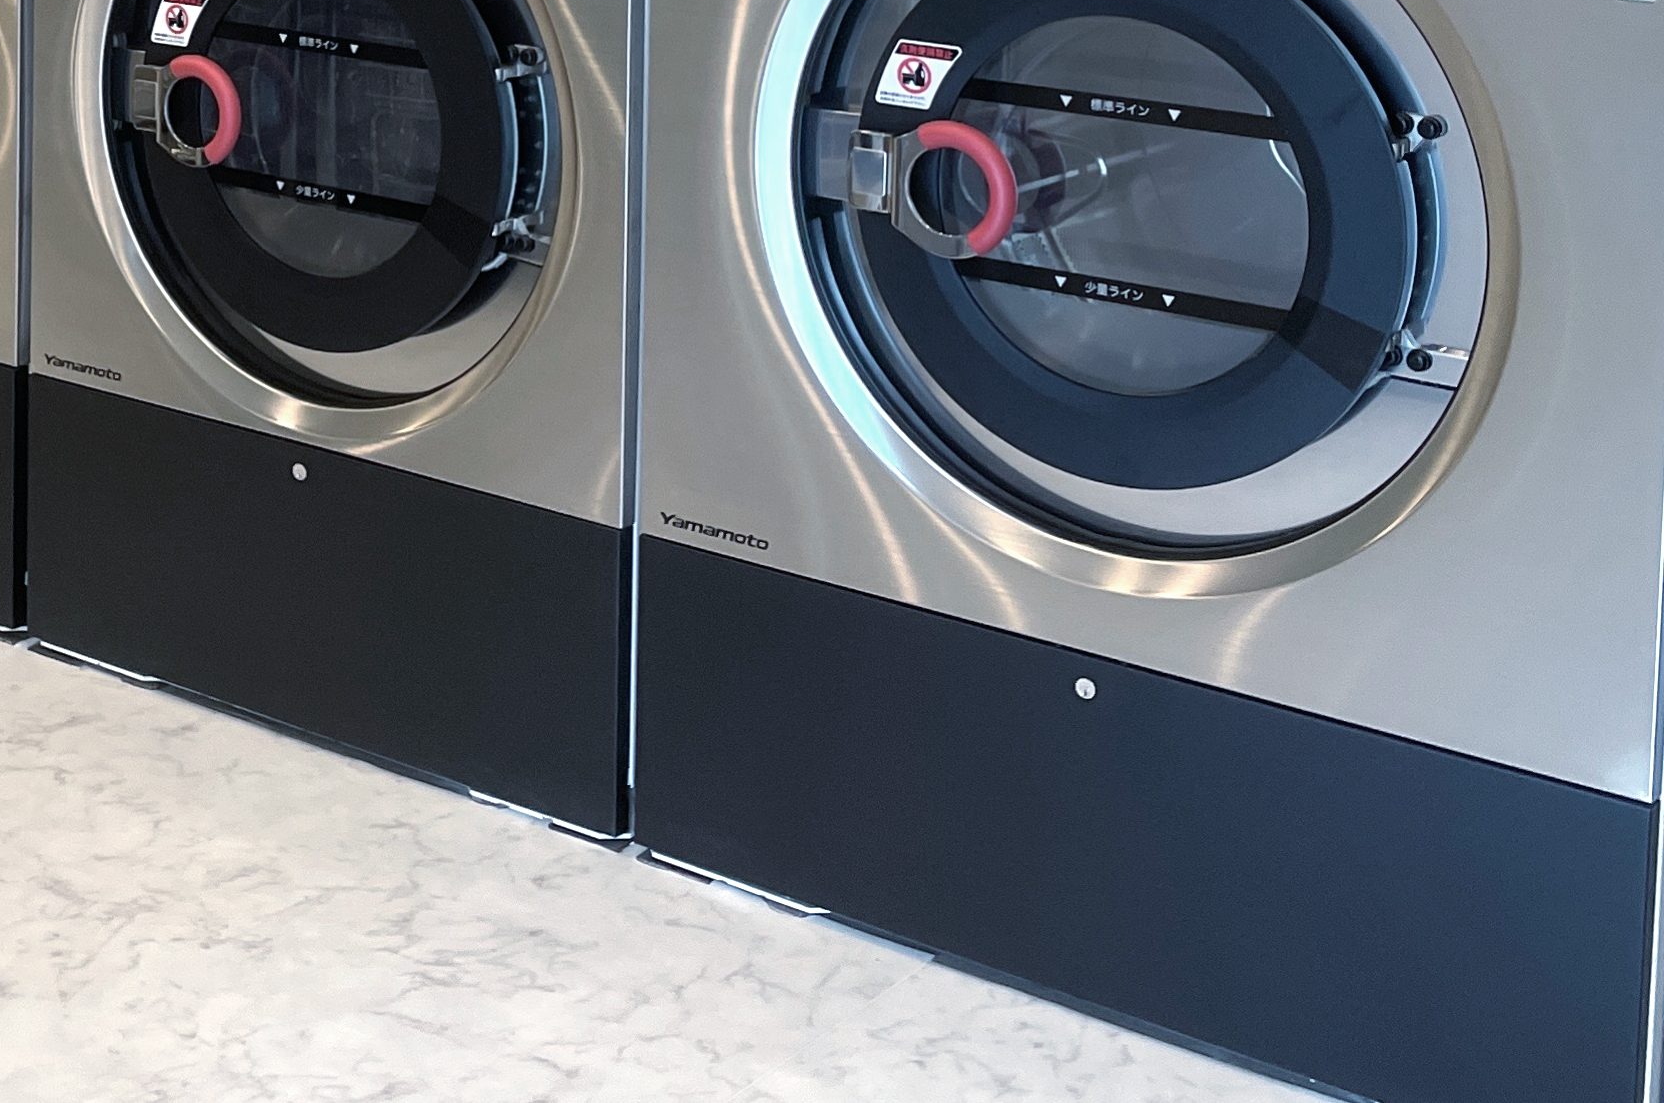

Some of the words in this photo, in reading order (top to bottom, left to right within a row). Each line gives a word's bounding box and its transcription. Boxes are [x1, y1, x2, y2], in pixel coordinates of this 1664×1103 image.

[1089, 97, 1151, 118] 標準ライン
[1084, 280, 1145, 302] 少量ライン
[44, 353, 122, 381] Yamamoto
[660, 511, 769, 550] Yamamoto
